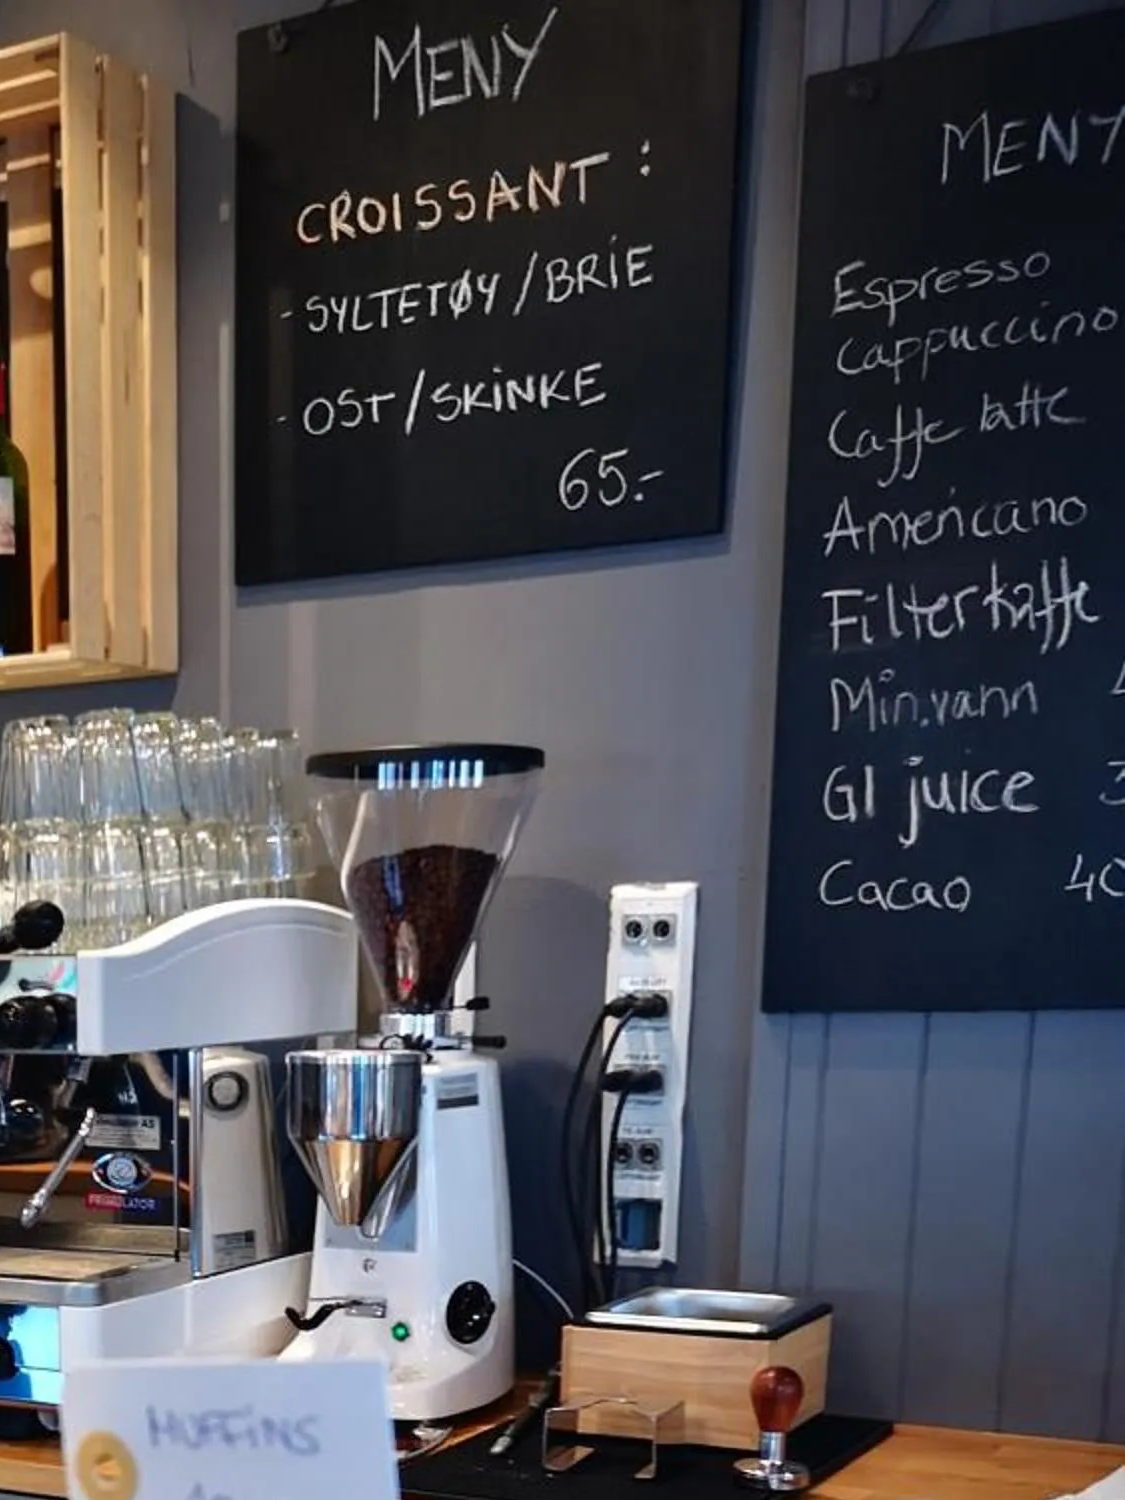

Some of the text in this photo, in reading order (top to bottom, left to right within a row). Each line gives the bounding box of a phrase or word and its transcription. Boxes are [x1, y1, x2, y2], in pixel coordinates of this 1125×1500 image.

[373, 6, 558, 121] MENY
[296, 152, 612, 244] CROISSANT
[831, 251, 1051, 329] Espresso
[836, 300, 1119, 385] Cappuccino
[823, 487, 1088, 557] Americano
[897, 756, 1039, 849] juice
[819, 859, 972, 912] Cacao
